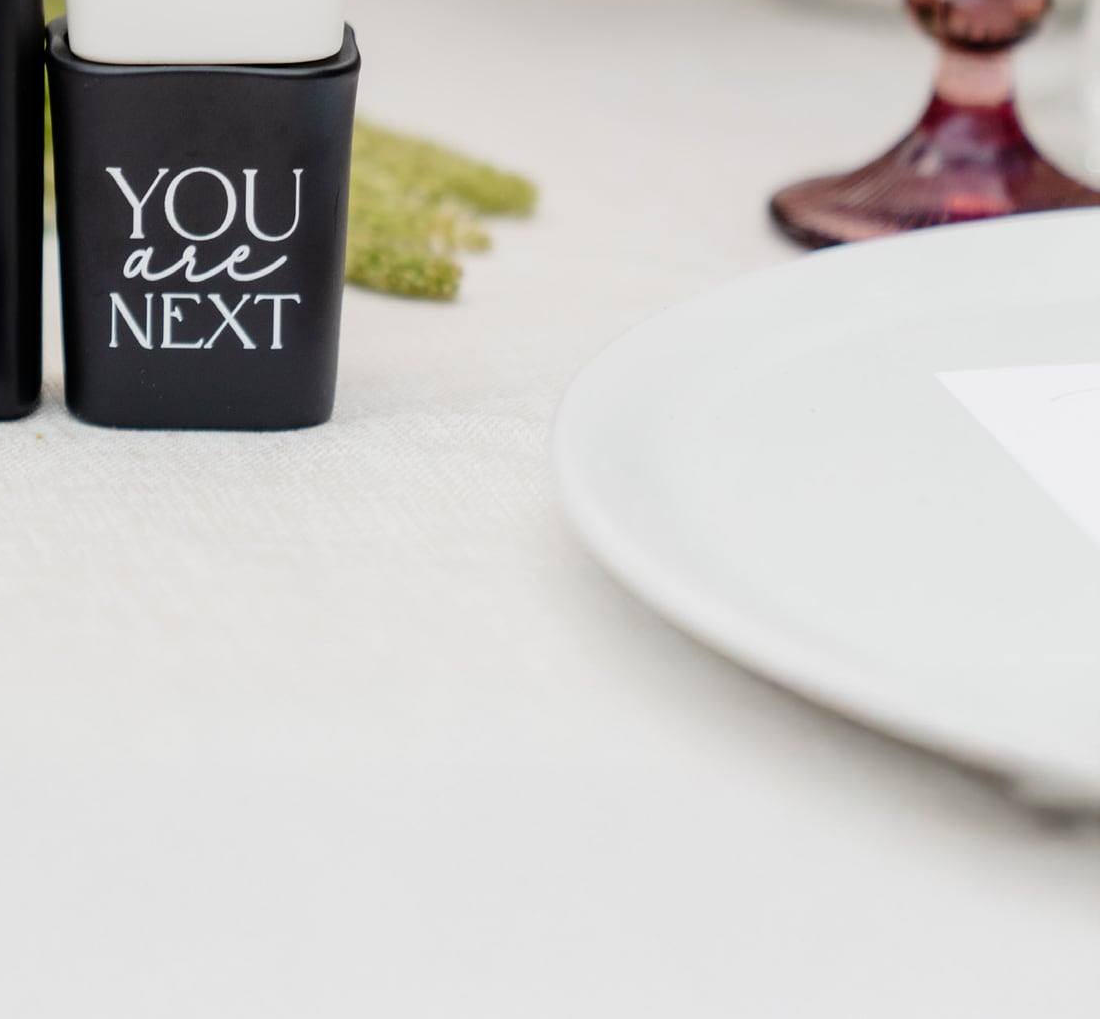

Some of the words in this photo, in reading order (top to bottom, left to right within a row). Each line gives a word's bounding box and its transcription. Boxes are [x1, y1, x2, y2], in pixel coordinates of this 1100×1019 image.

[105, 165, 305, 243] YOU
[121, 243, 289, 284] are
[107, 291, 302, 351] NEXT
